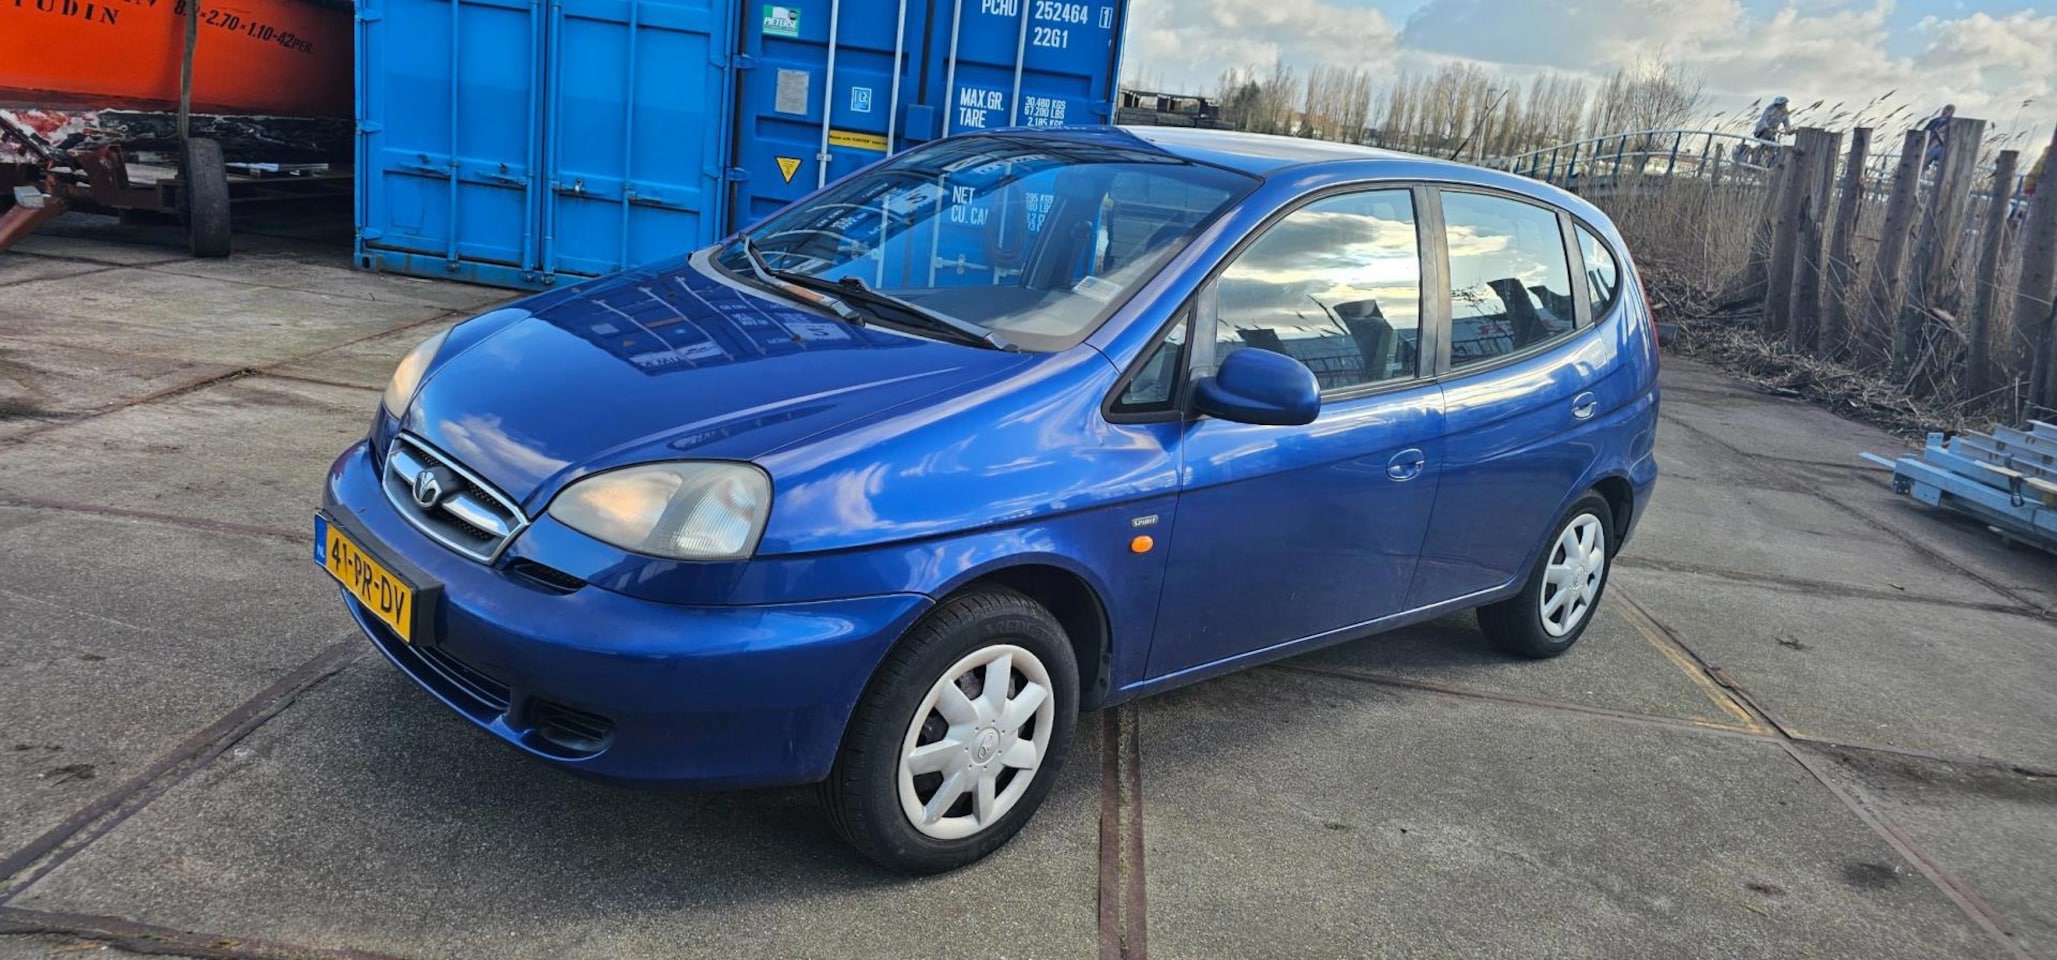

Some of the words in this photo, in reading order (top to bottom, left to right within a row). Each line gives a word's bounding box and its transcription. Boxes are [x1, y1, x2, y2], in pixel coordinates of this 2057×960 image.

[981, 0, 1018, 17] PCHU
[1035, 1, 1088, 24] 252464
[1033, 27, 1068, 48] 22G1
[1050, 107, 1066, 120] LBS
[1051, 99, 1067, 110] KGS
[959, 107, 987, 129] TARE
[952, 185, 976, 204] NET
[331, 537, 405, 625] 41-PR-DV
